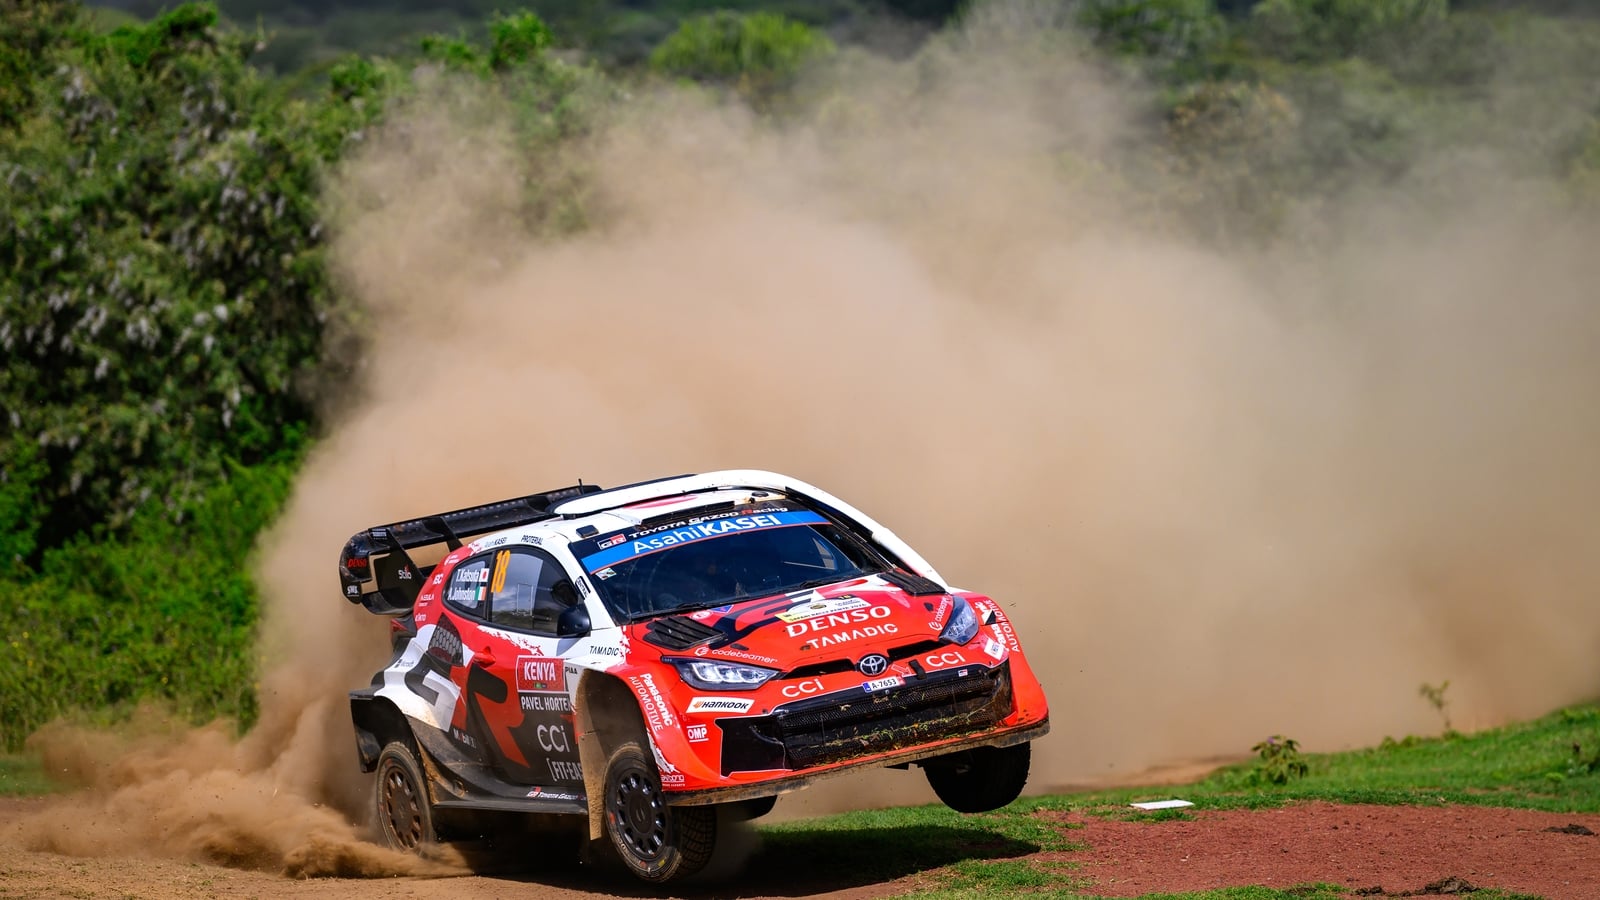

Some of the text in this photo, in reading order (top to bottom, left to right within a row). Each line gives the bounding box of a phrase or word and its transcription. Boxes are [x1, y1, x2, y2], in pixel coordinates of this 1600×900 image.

[628, 506, 788, 538] TOYOTA GAZOO Racing
[600, 534, 627, 550] GR
[347, 558, 367, 568] DENSO
[491, 549, 511, 593] 18
[786, 605, 891, 638] DENSO
[806, 623, 899, 650] TAMADIC
[589, 645, 620, 657] TAMADIC
[711, 648, 775, 665] codebeamer
[524, 661, 556, 681] KENYA
[565, 666, 578, 675] PIAA
[871, 678, 897, 689] A-7653
[521, 695, 544, 710] PAVEL
[629, 675, 663, 732] AUTOMOTIVE
[640, 673, 673, 727] Panasonic
[687, 727, 708, 740] OMP
